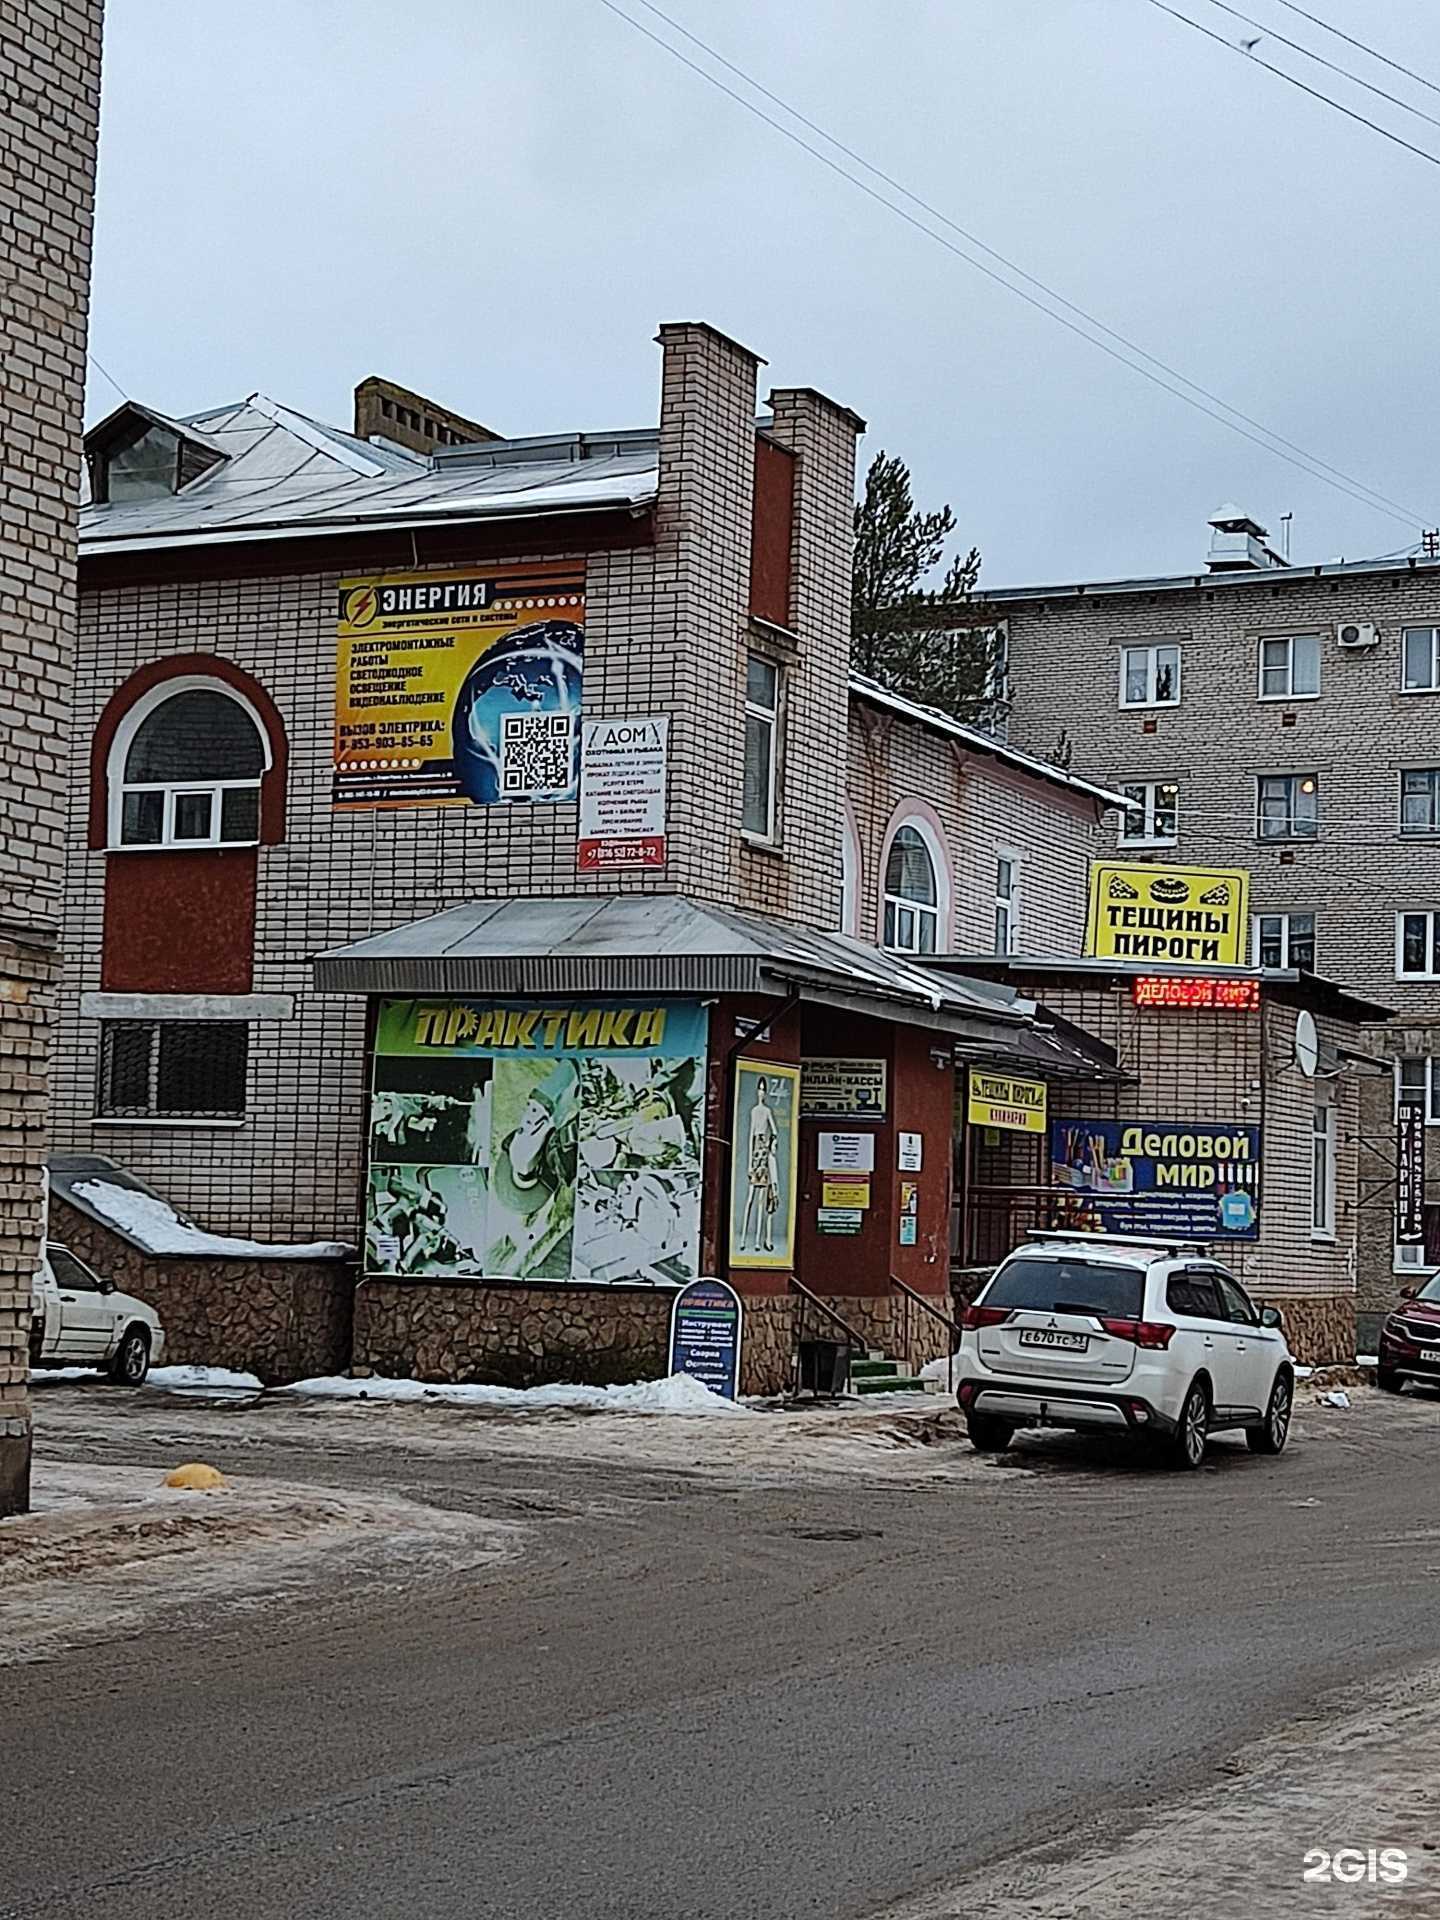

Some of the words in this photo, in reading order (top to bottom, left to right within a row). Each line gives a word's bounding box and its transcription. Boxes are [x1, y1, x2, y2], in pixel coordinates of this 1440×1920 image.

[382, 583, 487, 612] ЭНЕРГИЯ
[351, 636, 455, 654] ЭЛЕКТРОМОНТАЖНЫЕ
[350, 654, 388, 668] РАБОТЫ
[350, 666, 423, 681] СВЕТОДИОДНОЕ
[349, 681, 406, 694] ОСВЕЩЕНИЕ
[349, 692, 445, 709] ВИДЕОНАБЛЮДЕНИЕ
[340, 723, 376, 737] ВЫЗОВ
[379, 720, 445, 734] ЭЛЕКТРИКА:
[604, 727, 646, 747] ДОМ
[585, 748, 625, 756] ОХОТНИКА
[634, 746, 663, 754] РЫБАКА
[1106, 905, 1230, 934] ТЕЩИНЫ
[1114, 933, 1220, 962] ПИРОГИ
[414, 1007, 667, 1047] ПРАКТИКА
[1120, 1127, 1250, 1160] Деловой
